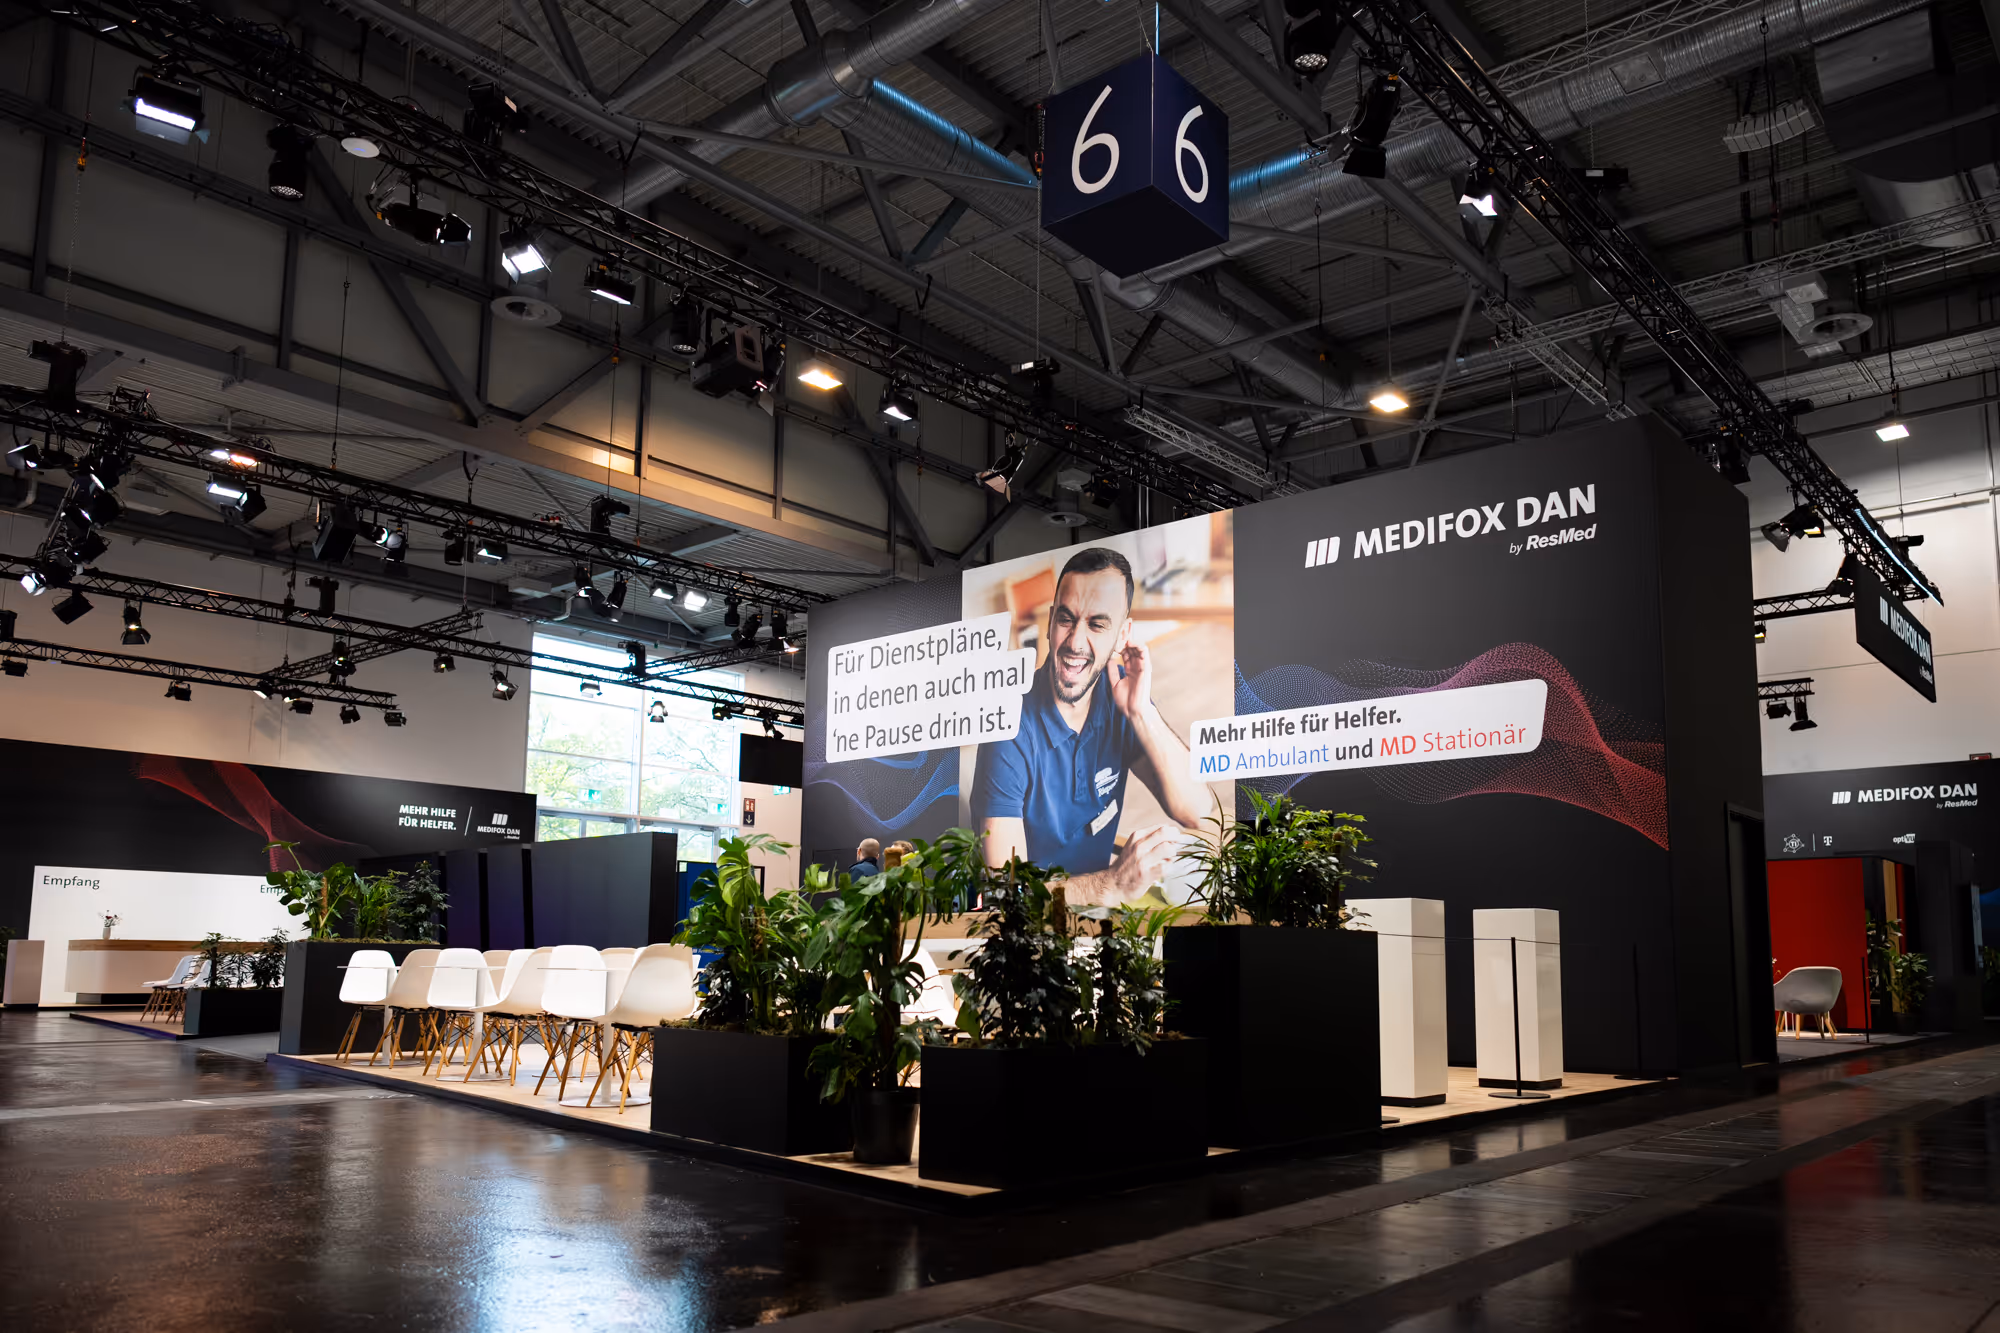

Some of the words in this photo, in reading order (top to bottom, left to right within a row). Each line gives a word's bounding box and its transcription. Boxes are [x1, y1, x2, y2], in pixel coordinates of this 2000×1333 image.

[1071, 84, 1120, 194] 6
[1175, 104, 1209, 204] 6
[1353, 502, 1506, 559] MEDIFOX
[1516, 483, 1596, 528] DAN
[1509, 542, 1523, 555] by
[1526, 523, 1597, 551] ResMed
[834, 649, 865, 676] Für
[870, 627, 1002, 669] Dienstpläne,
[834, 691, 850, 715] in
[856, 683, 918, 711] denen
[924, 667, 976, 699] auch
[984, 657, 1025, 690] mal
[865, 722, 923, 749] Pause
[929, 712, 971, 740] drin
[979, 705, 1012, 733] ist.
[1199, 724, 1247, 745] Mehr
[1251, 716, 1296, 739] Hilfe
[1300, 712, 1329, 734] für
[1334, 705, 1402, 730] Helfer.
[1199, 754, 1231, 774] MD
[1235, 744, 1330, 772] Ambulant
[1335, 738, 1374, 762] und
[1379, 735, 1417, 758] MD
[1423, 724, 1527, 754] Stationär
[399, 804, 429, 816] MEHR
[430, 807, 457, 818] HILFE
[1857, 785, 1935, 803] MEDIFOX
[1939, 783, 1978, 798] DAN
[1944, 799, 1978, 808] ResMed
[398, 816, 418, 828] FÜR
[420, 819, 457, 831] HELFER.
[477, 825, 506, 835] MEDIFOX
[506, 828, 520, 836] DAN
[43, 874, 101, 890] Empfang
